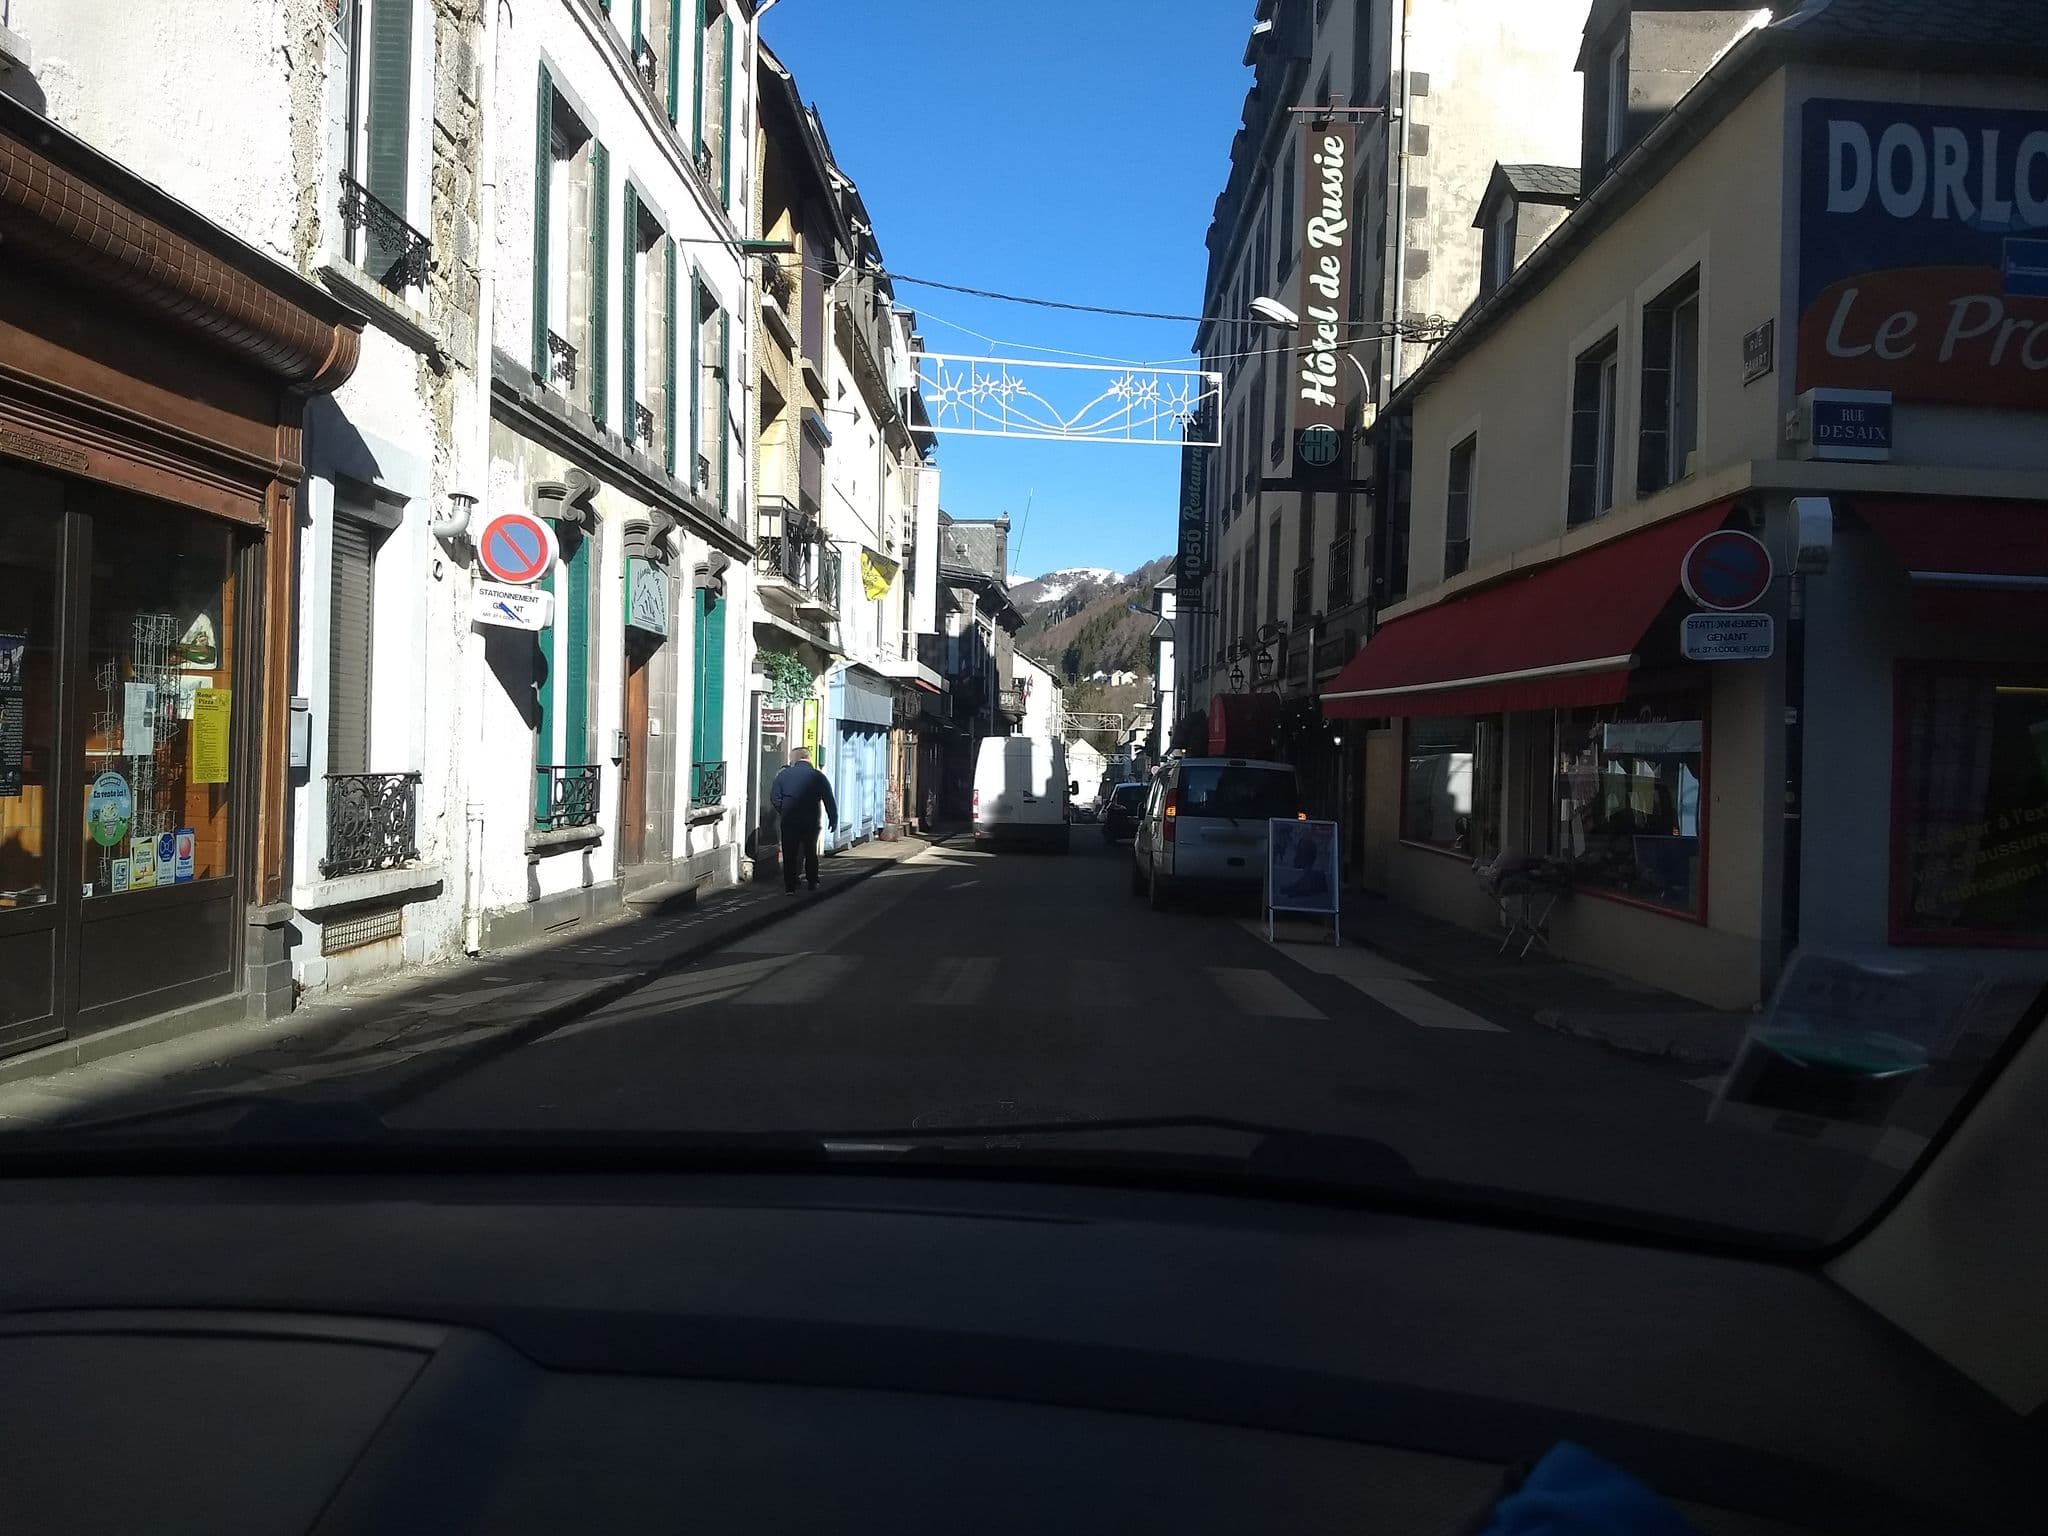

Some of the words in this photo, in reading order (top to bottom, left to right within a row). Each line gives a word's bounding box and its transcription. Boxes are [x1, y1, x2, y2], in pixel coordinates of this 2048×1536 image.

[1307, 135, 1348, 249] Russie
[1309, 255, 1341, 299] de
[1825, 287, 1918, 360] Le
[1301, 305, 1340, 407] Hôtel
[1819, 424, 1886, 440] DESAIX
[1841, 408, 1865, 422] RUE
[1183, 429, 1203, 522] Restaurat
[1183, 529, 1202, 580] 1050
[479, 588, 540, 604] STATIONNEMENT
[1687, 619, 1769, 630] STATIONNEMENT
